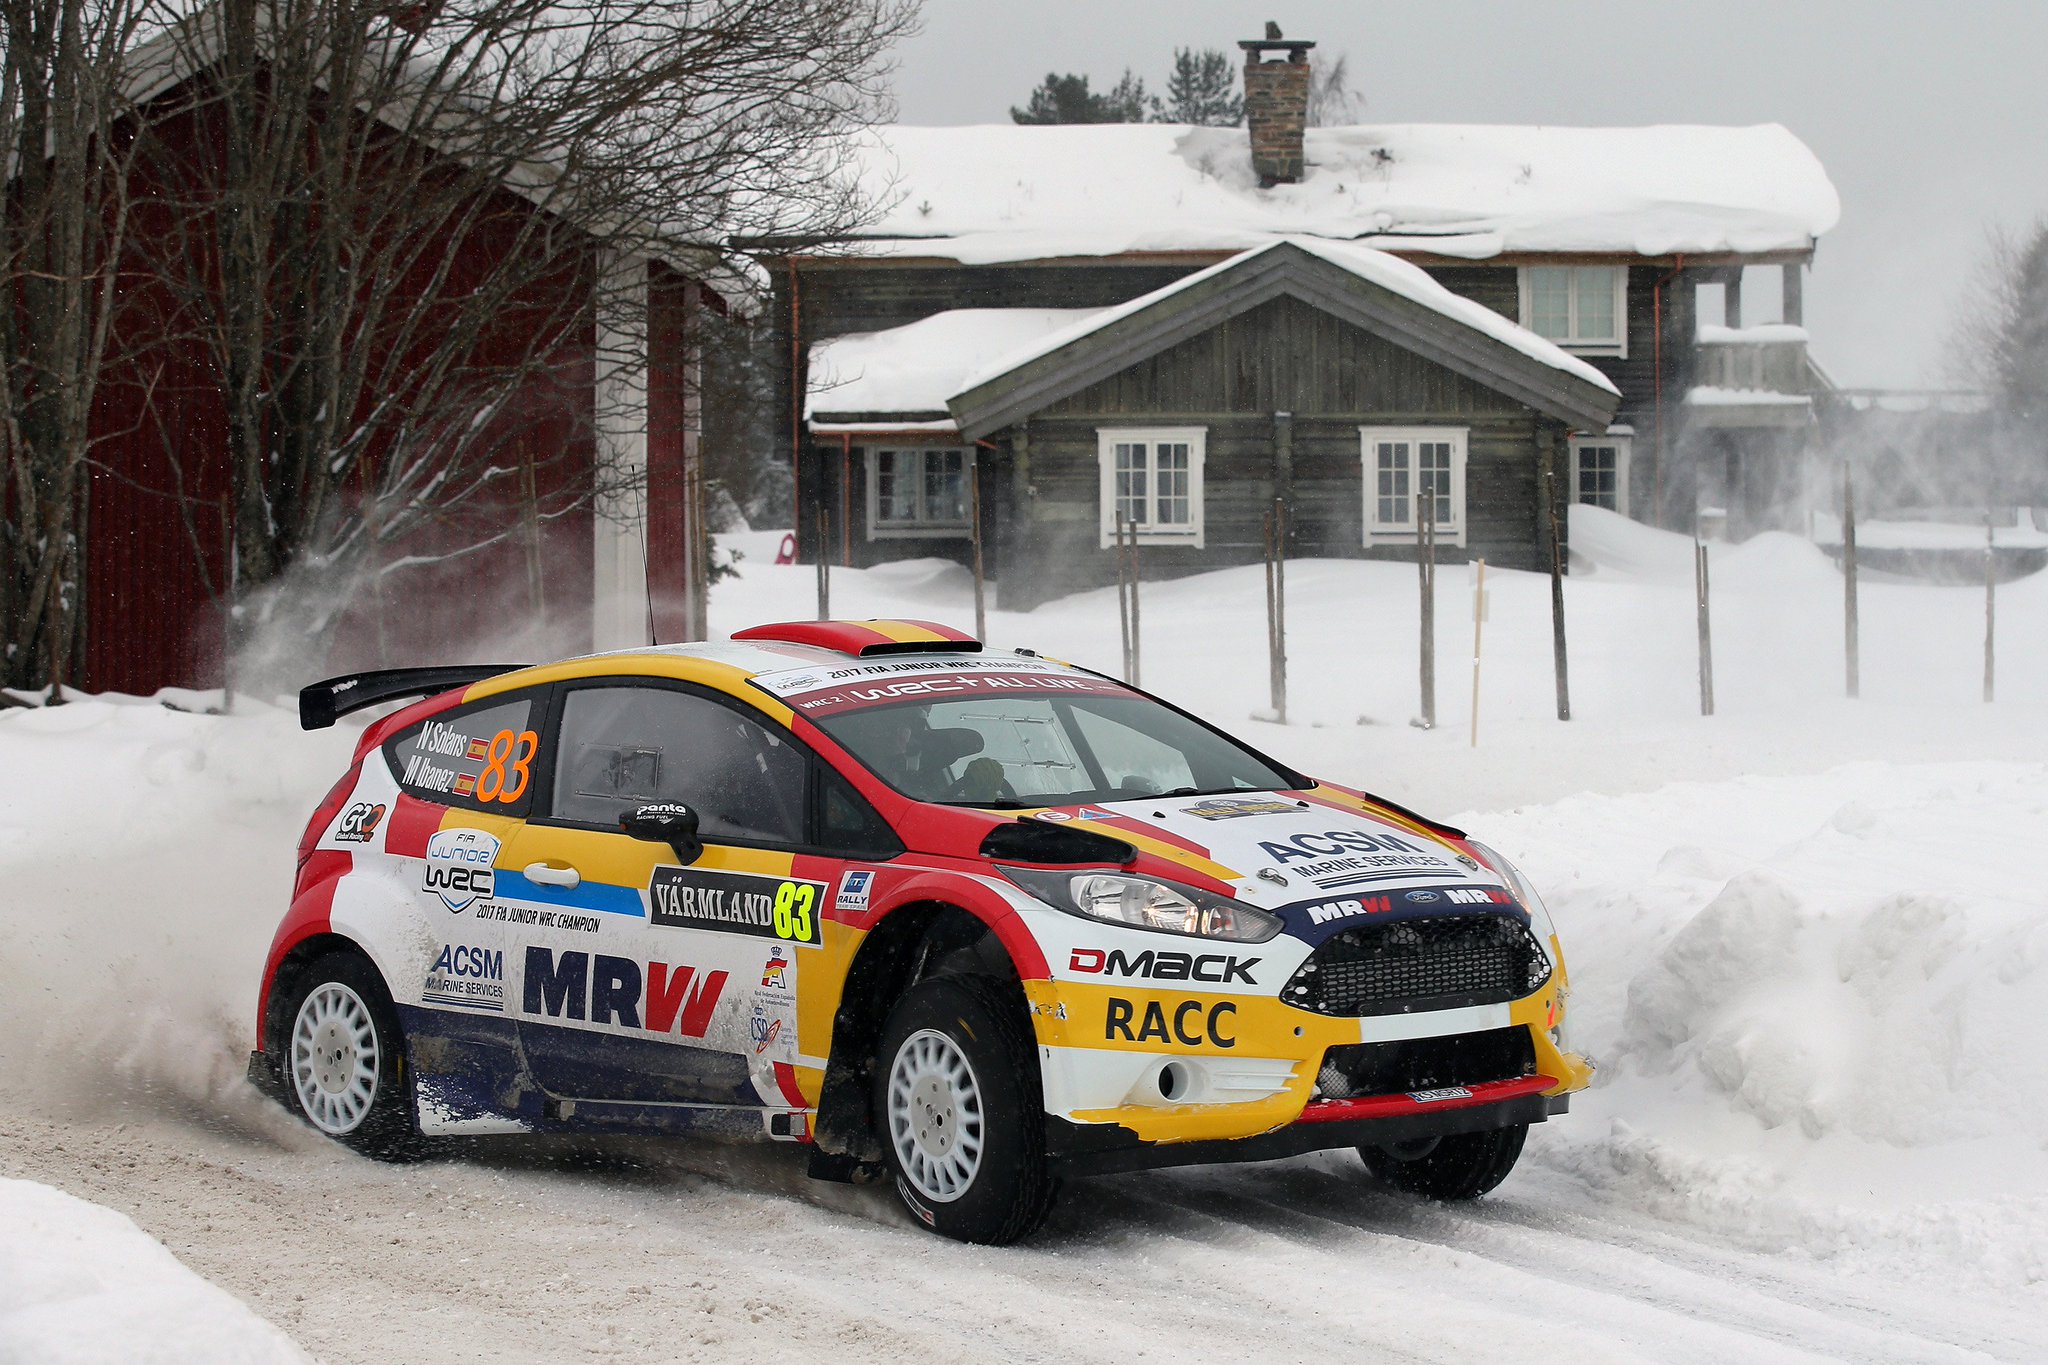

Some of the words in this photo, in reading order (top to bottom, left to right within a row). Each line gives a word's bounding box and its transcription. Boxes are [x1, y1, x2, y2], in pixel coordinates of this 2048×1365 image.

[826, 667, 862, 680] 2017
[863, 663, 890, 675] FIA
[891, 661, 943, 673] JUNIOR
[943, 661, 977, 669] WRC
[979, 661, 1048, 671] CHAMPION
[984, 676, 1032, 689] ALL
[1031, 677, 1094, 690] LIVE
[799, 698, 829, 709] WRC
[831, 696, 844, 704] 2
[416, 720, 434, 750] N
[428, 722, 467, 758] Solans
[402, 754, 422, 786] M
[415, 758, 455, 793] Ibanez
[476, 729, 538, 804] 83
[636, 803, 686, 816] panta
[456, 833, 475, 844] FIA
[1257, 831, 1426, 864] ACSM
[431, 846, 490, 863] JUNIOR
[1291, 858, 1364, 878] MARINE
[1363, 856, 1449, 868] SERVICES
[426, 864, 493, 893] WRC
[655, 875, 773, 927] VÄRMLAND
[773, 881, 816, 942] 83
[837, 895, 868, 904] RALLY
[1306, 895, 1392, 925] MRW
[1443, 889, 1512, 905] MRW
[476, 904, 495, 920] 2017
[495, 906, 507, 921] FIA
[507, 908, 538, 925] JUNIOR
[538, 912, 557, 928] WRC
[557, 914, 601, 934] CHAMPION
[431, 943, 503, 981] ACSM
[425, 976, 465, 992] MARINE
[465, 981, 503, 998] SERVICES
[522, 945, 730, 1038] MRW
[1105, 997, 1237, 1048] RACC
